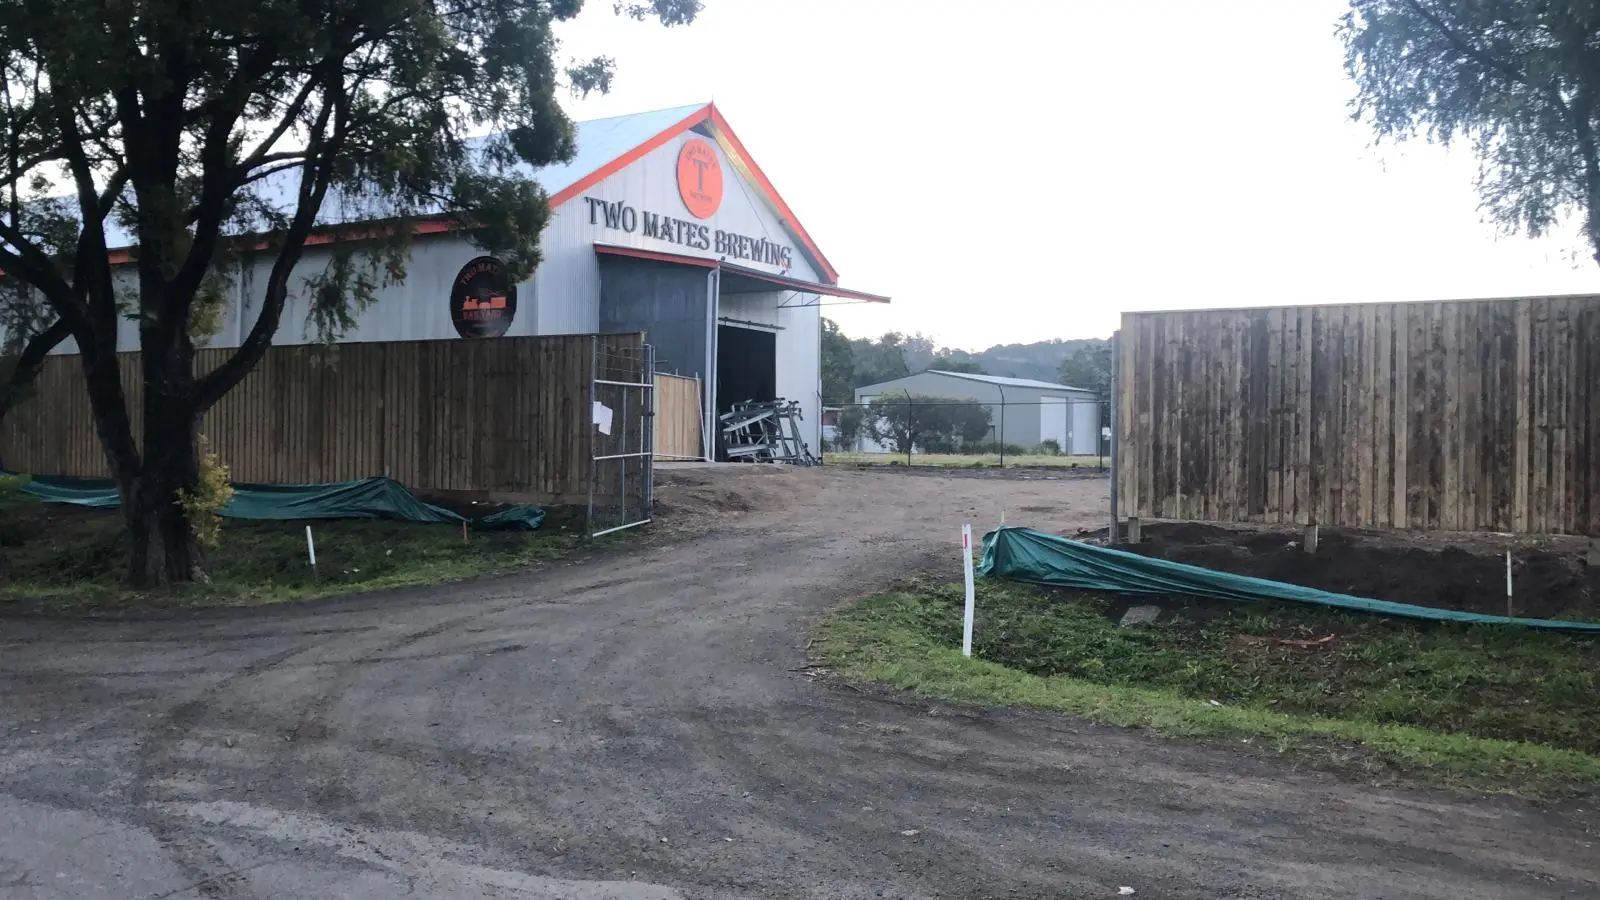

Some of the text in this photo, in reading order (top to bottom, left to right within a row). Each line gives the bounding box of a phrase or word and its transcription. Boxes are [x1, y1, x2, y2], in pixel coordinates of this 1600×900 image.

[692, 158, 708, 193] T
[585, 196, 793, 269] TWO MATES BREWING
